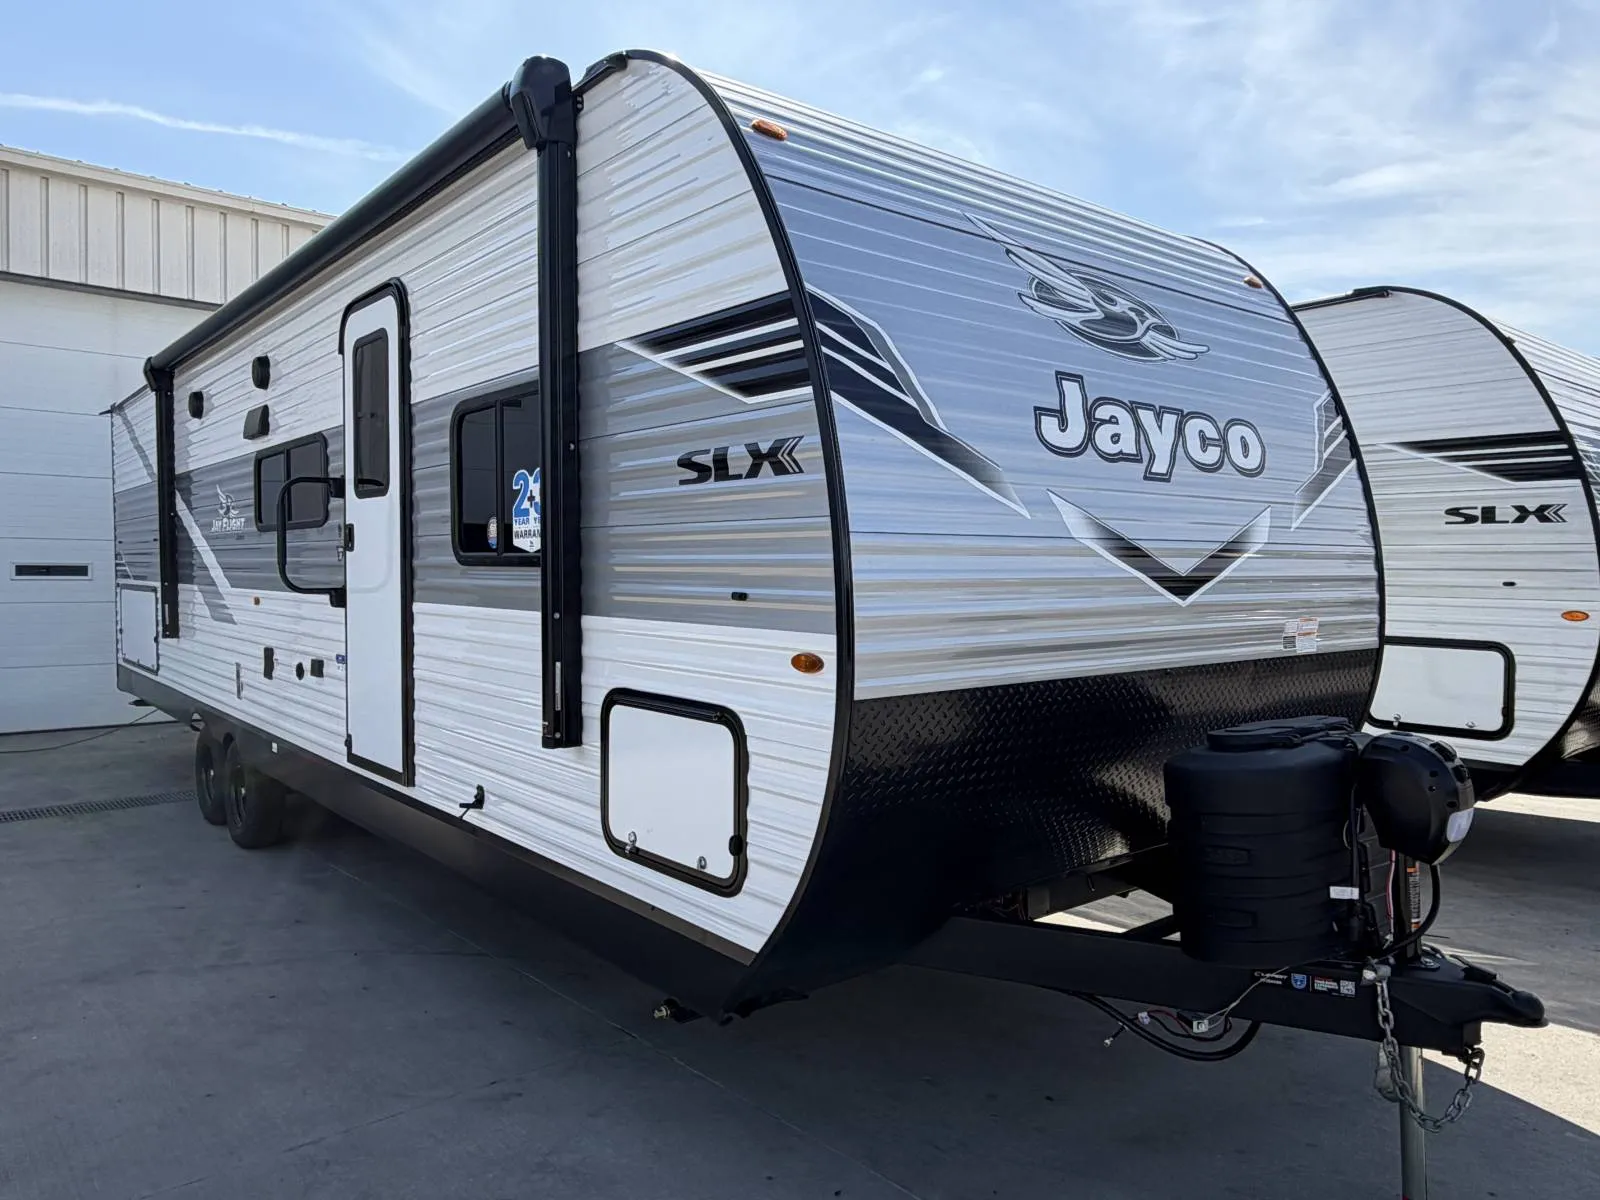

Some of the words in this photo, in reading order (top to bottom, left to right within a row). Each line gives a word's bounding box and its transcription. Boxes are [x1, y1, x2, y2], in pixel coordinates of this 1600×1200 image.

[1033, 370, 1266, 483] Jayco
[677, 435, 805, 486] SLX
[514, 517, 530, 526] YEAR
[1444, 503, 1568, 525] SLX
[514, 528, 541, 539] WARRAN
